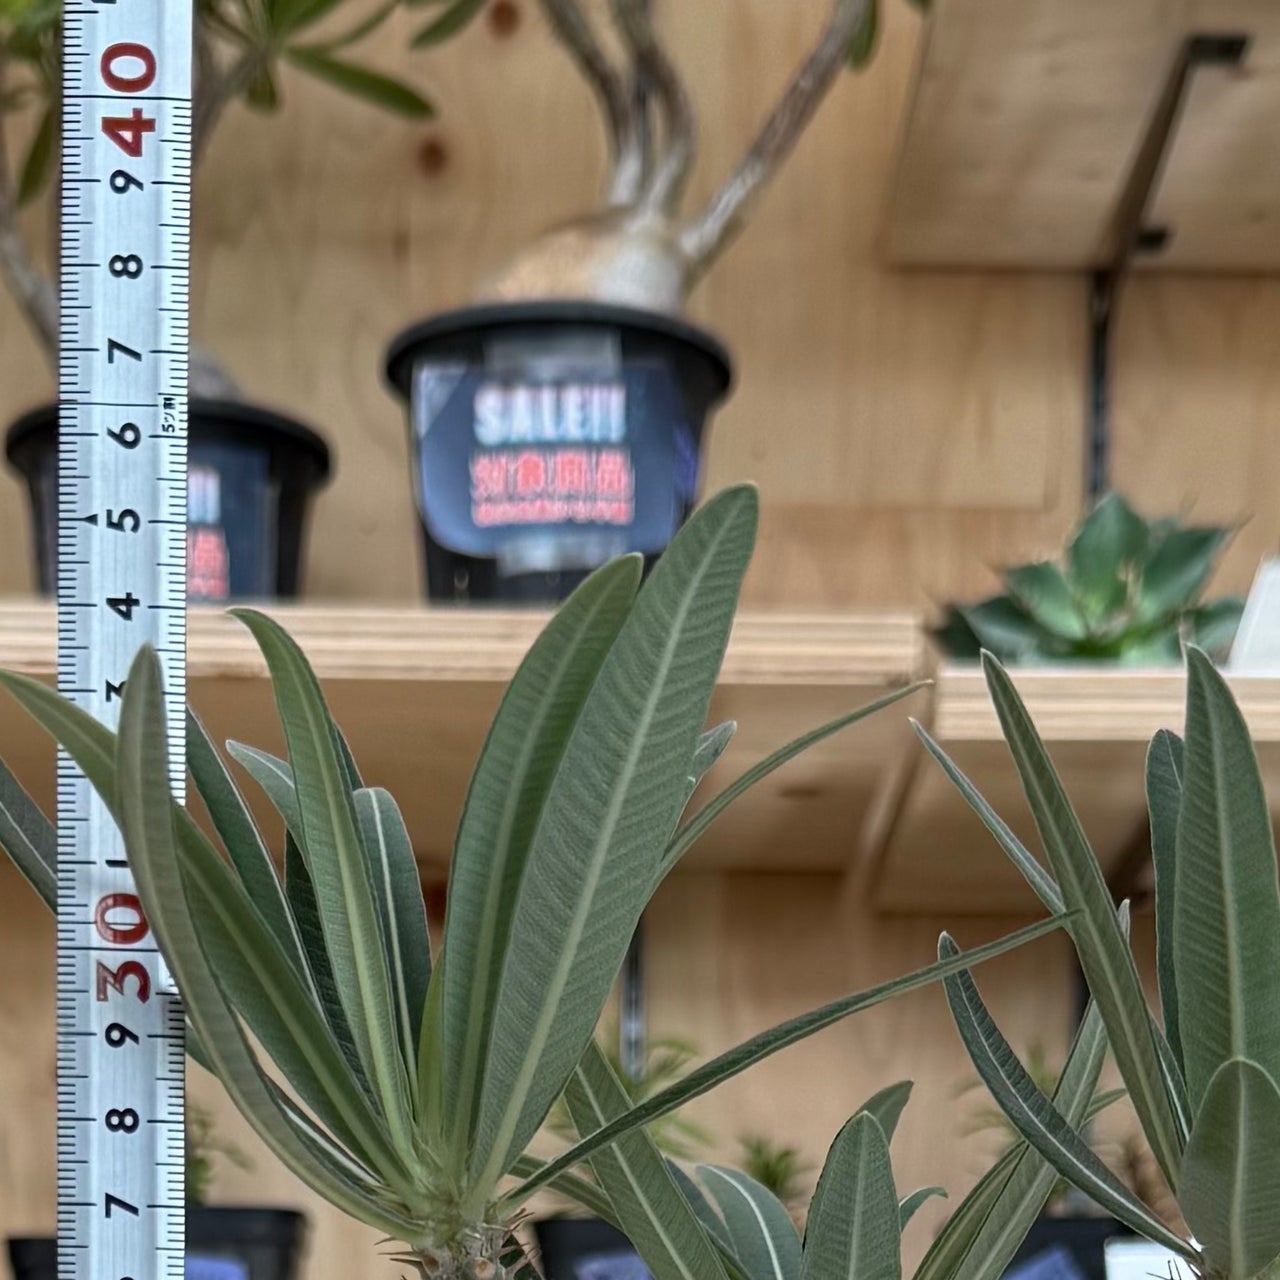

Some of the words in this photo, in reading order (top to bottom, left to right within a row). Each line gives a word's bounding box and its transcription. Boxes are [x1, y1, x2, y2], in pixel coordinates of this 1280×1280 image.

[100, 42, 157, 158] 40
[109, 169, 144, 195] 9
[108, 253, 144, 280] 8
[107, 337, 142, 364] 7
[106, 422, 142, 450] 6
[105, 508, 141, 534] 5
[105, 592, 141, 621] 4
[94, 892, 151, 1005] 30
[104, 1022, 140, 1049] 9
[104, 1107, 140, 1135] 8
[104, 1192, 140, 1219] 7
